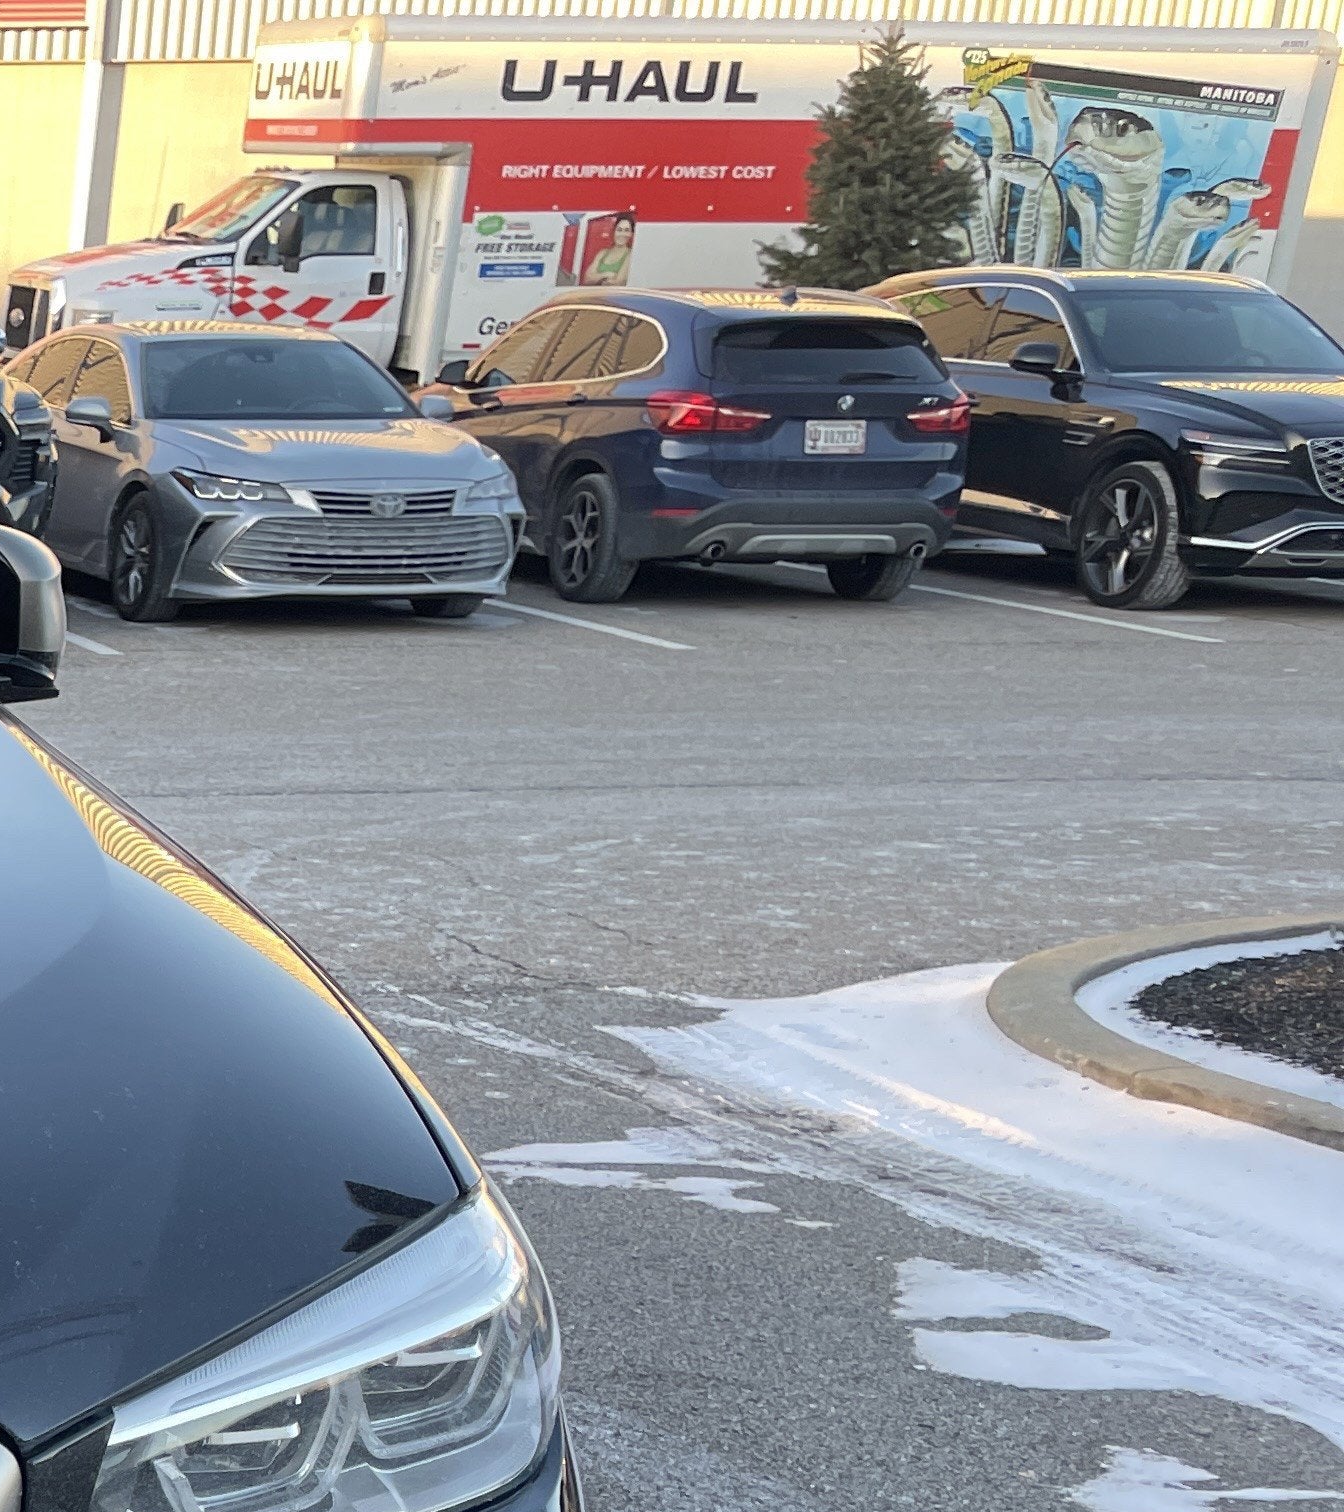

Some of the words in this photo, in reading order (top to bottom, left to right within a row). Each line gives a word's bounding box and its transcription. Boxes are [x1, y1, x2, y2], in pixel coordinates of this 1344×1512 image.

[254, 60, 343, 101] U-HAUL
[500, 59, 759, 104] U-HAUL
[1199, 86, 1276, 106] MANITOBA
[501, 164, 550, 180] RIGHT
[551, 164, 647, 180] EQUIPMENT
[662, 164, 729, 180] LOWEST
[731, 164, 776, 180] COST
